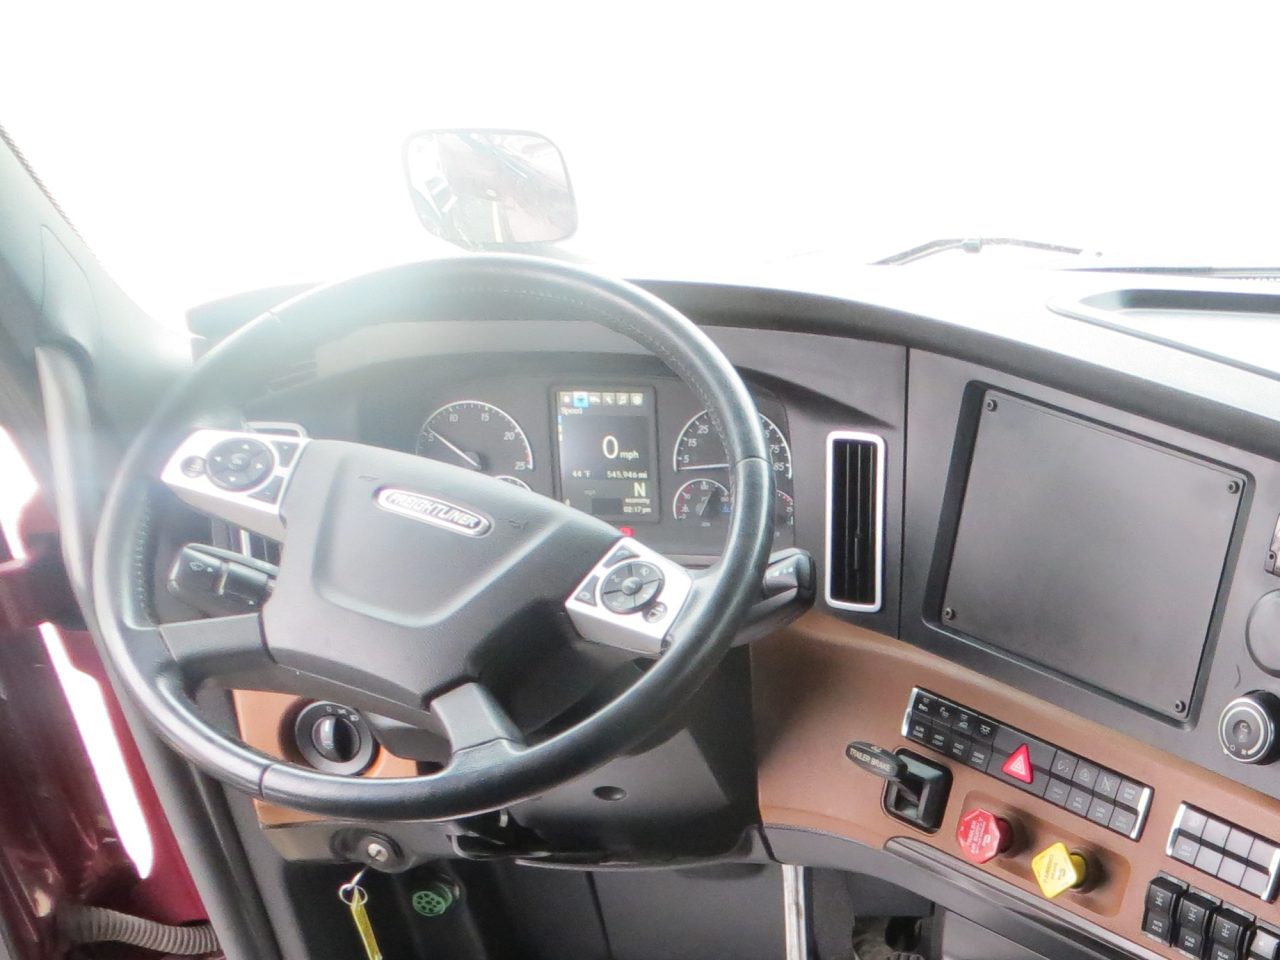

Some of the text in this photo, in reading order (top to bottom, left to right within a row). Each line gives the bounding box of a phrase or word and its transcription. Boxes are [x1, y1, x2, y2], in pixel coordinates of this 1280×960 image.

[449, 413, 459, 422] 10
[481, 413, 490, 422] 15
[698, 424, 709, 435] 25
[504, 431, 516, 441] 20
[602, 435, 640, 461] 0 mph
[687, 438, 697, 448] 15
[770, 444, 780, 454] 75
[683, 455, 690, 464] 5
[514, 461, 526, 471] 25
[772, 462, 785, 472] 85
[633, 482, 646, 497] N
[385, 491, 480, 528] FREIGHTLINER
[848, 748, 892, 772] TRAILER BRAKE
